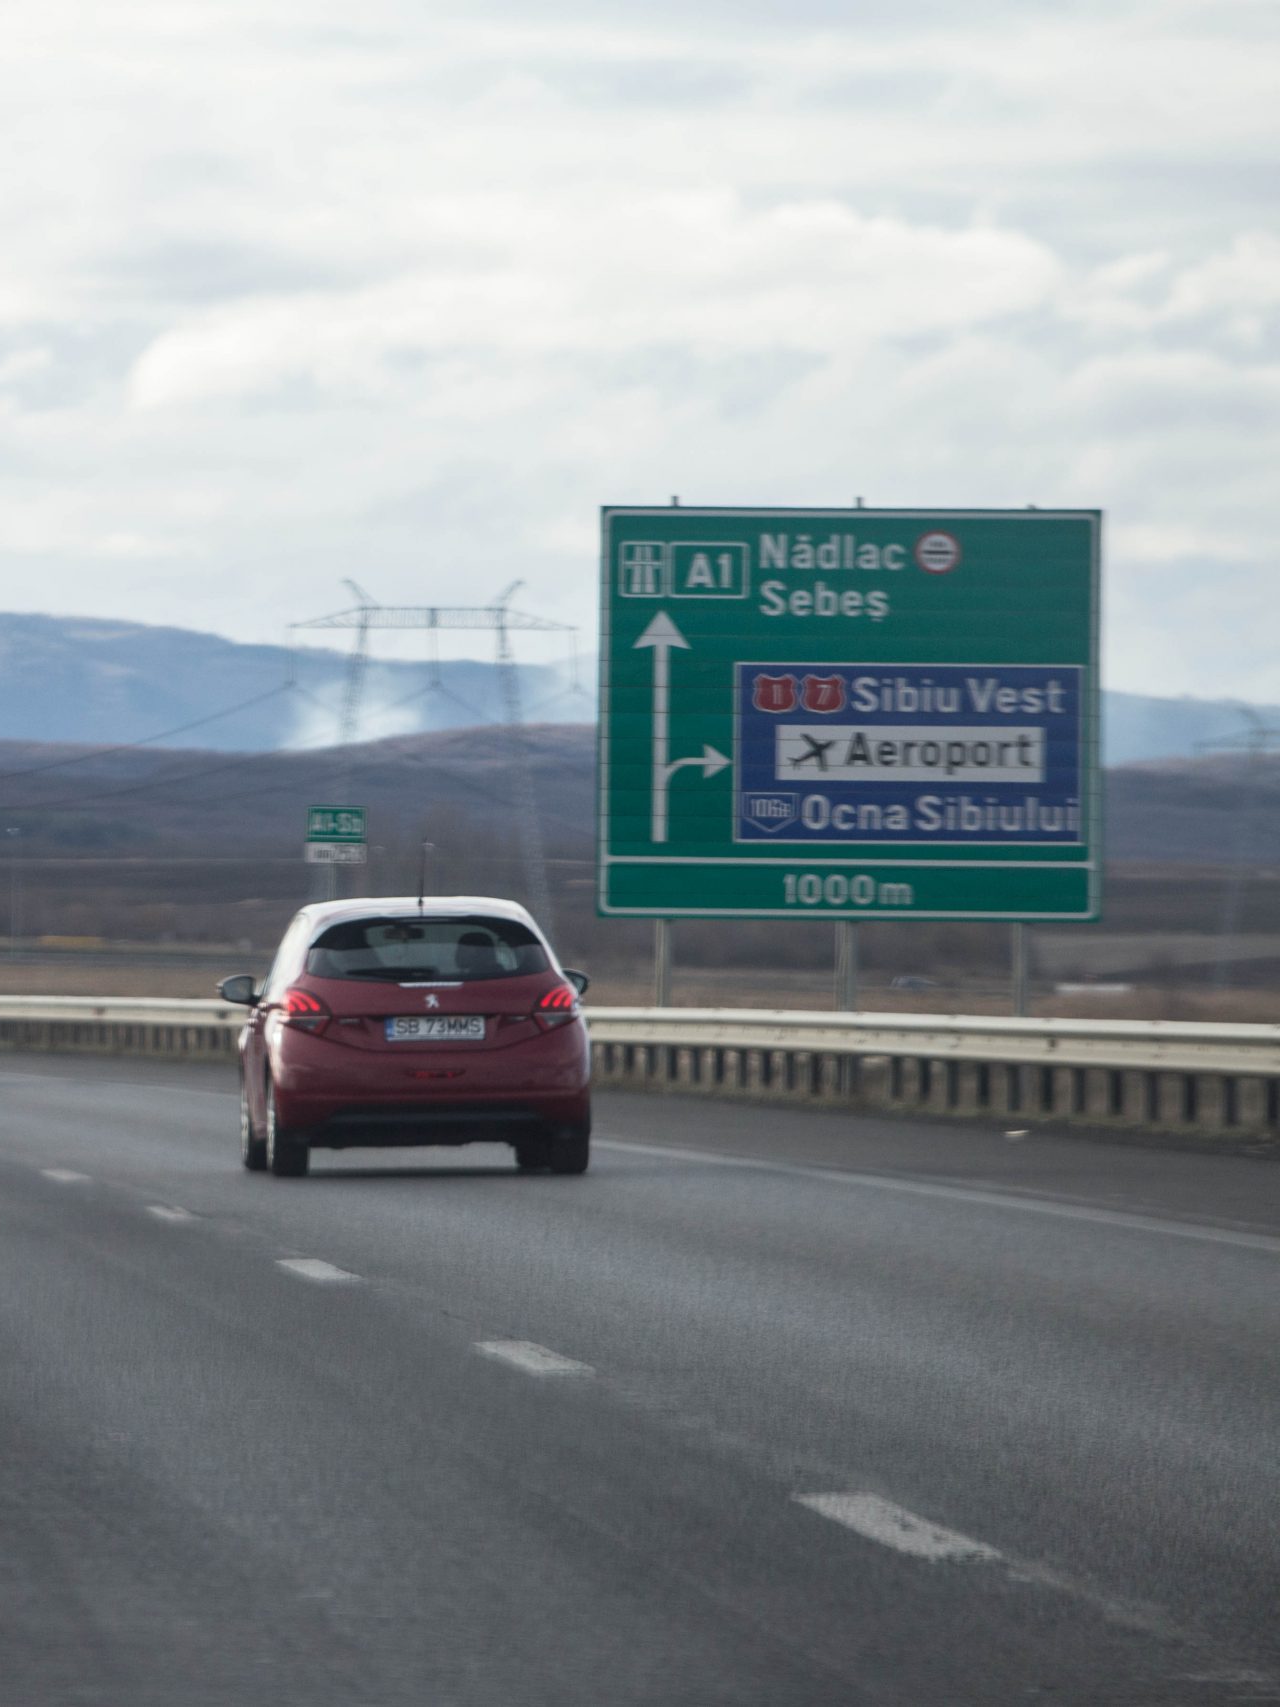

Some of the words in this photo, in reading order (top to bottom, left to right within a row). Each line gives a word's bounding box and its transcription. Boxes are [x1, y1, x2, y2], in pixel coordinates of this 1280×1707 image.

[759, 533, 906, 571] Nădlac
[685, 553, 733, 589] A1
[816, 684, 831, 705] 7
[851, 677, 961, 713] Sibiu
[965, 678, 1067, 714] Vest
[845, 732, 1035, 776] Aeroport
[801, 794, 910, 831] Ocna
[913, 795, 1081, 832] Sibiului
[783, 873, 875, 905] 1000
[878, 882, 913, 905] m
[396, 1018, 420, 1034] SB
